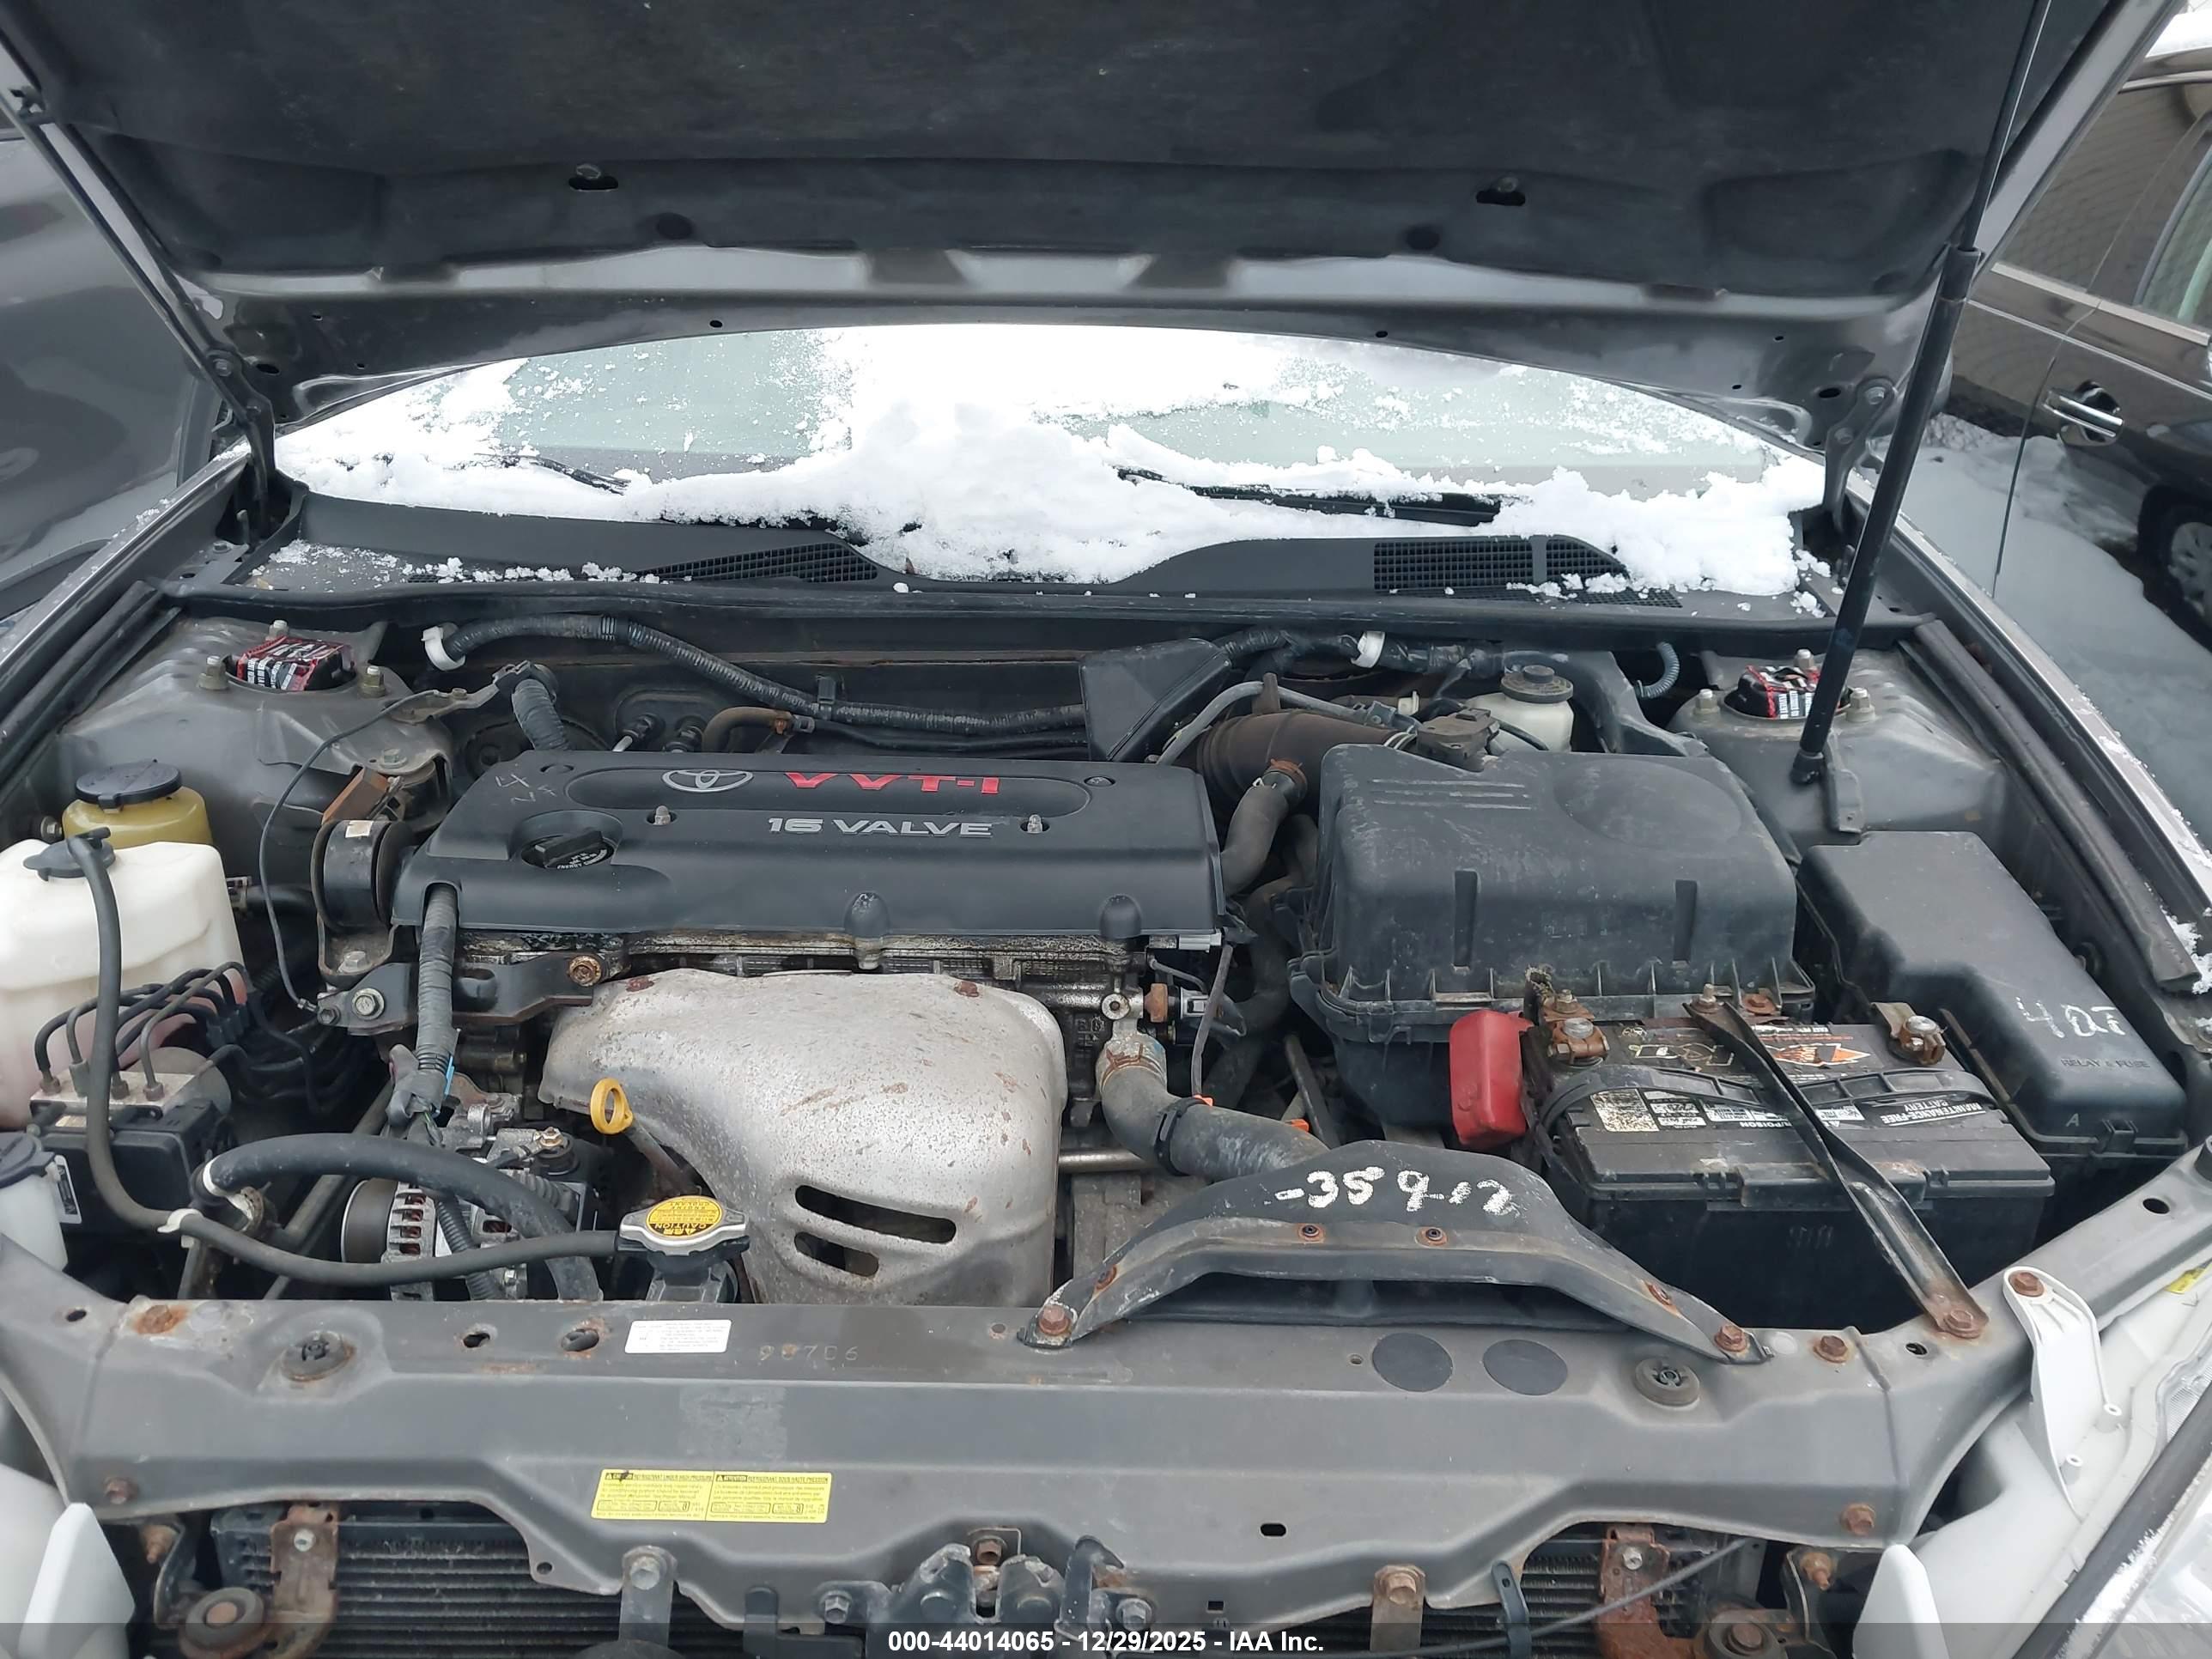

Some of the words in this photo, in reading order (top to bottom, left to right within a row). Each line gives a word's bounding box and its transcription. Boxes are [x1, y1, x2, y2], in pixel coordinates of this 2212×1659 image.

[769, 817, 823, 832] 16
[832, 819, 993, 837] VALVE
[2061, 1058, 2100, 1067] RELAY
[2115, 1059, 2150, 1068] FUSE
[1881, 1102, 1983, 1124] MAINTENANCE-FREE
[1903, 1099, 1949, 1112] BATTERY
